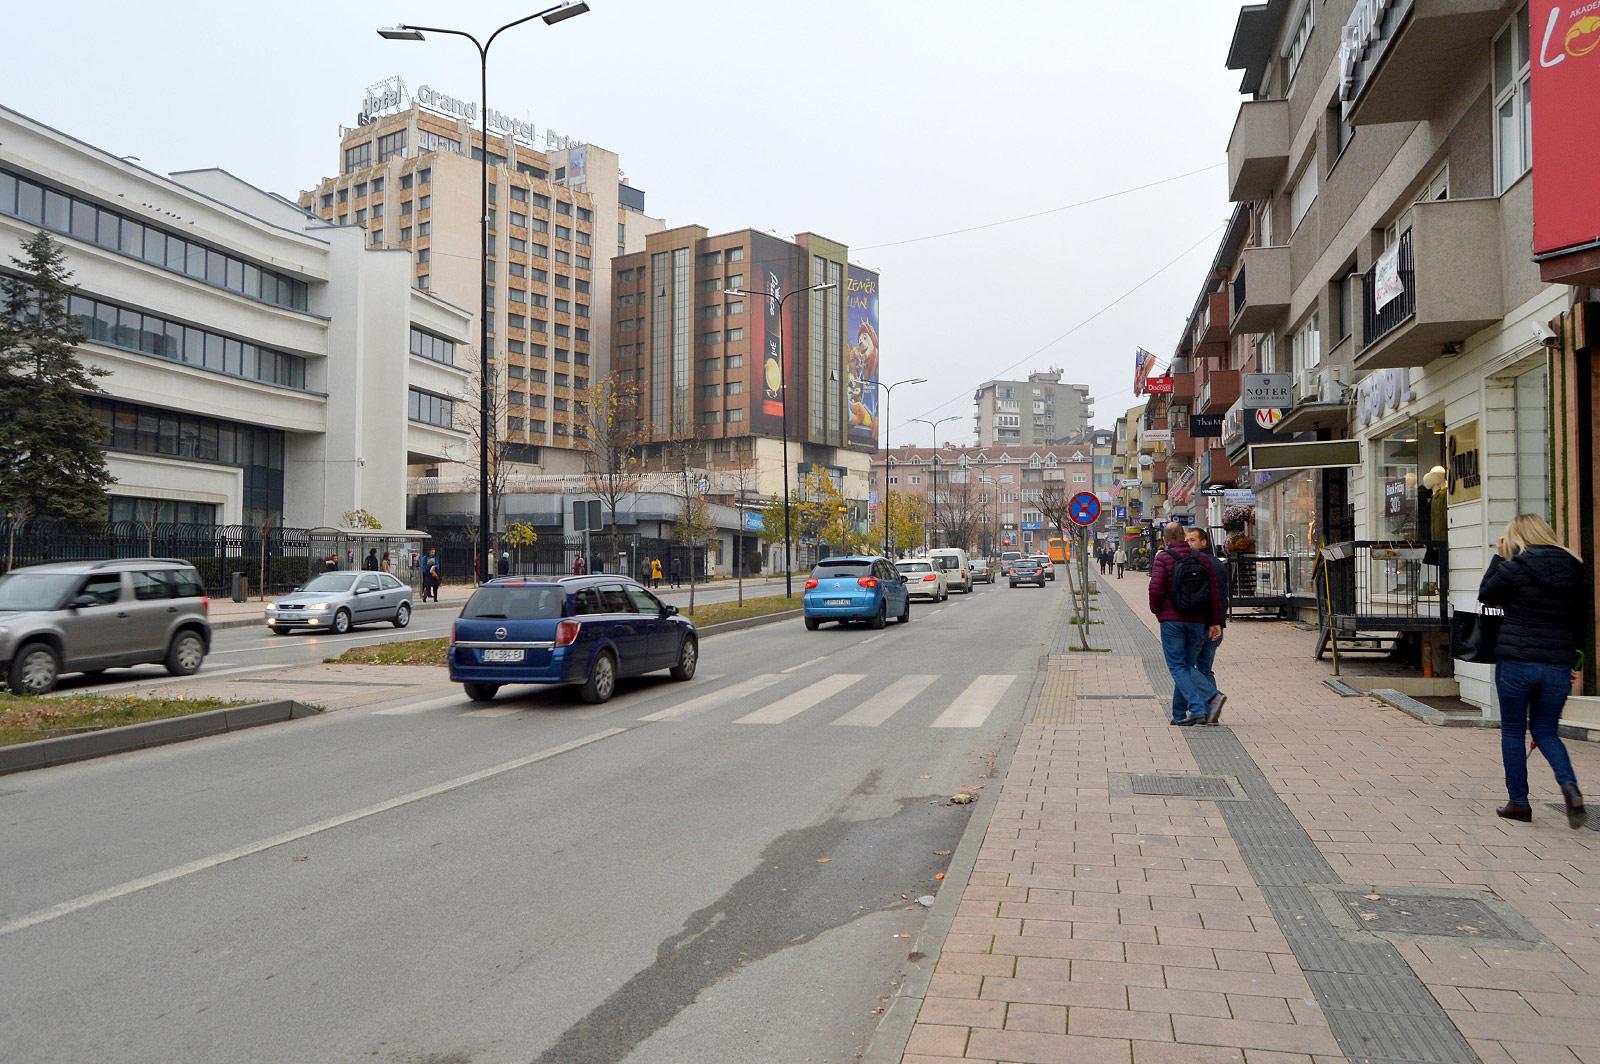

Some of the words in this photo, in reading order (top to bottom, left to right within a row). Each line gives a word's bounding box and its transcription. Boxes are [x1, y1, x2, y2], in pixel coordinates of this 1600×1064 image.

[362, 85, 401, 116] Hotel
[418, 85, 477, 120] Grand
[488, 108, 535, 141] Hotel
[1247, 388, 1287, 396] NOTER
[1357, 368, 1416, 425] COOL
[1197, 417, 1213, 426] Thai
